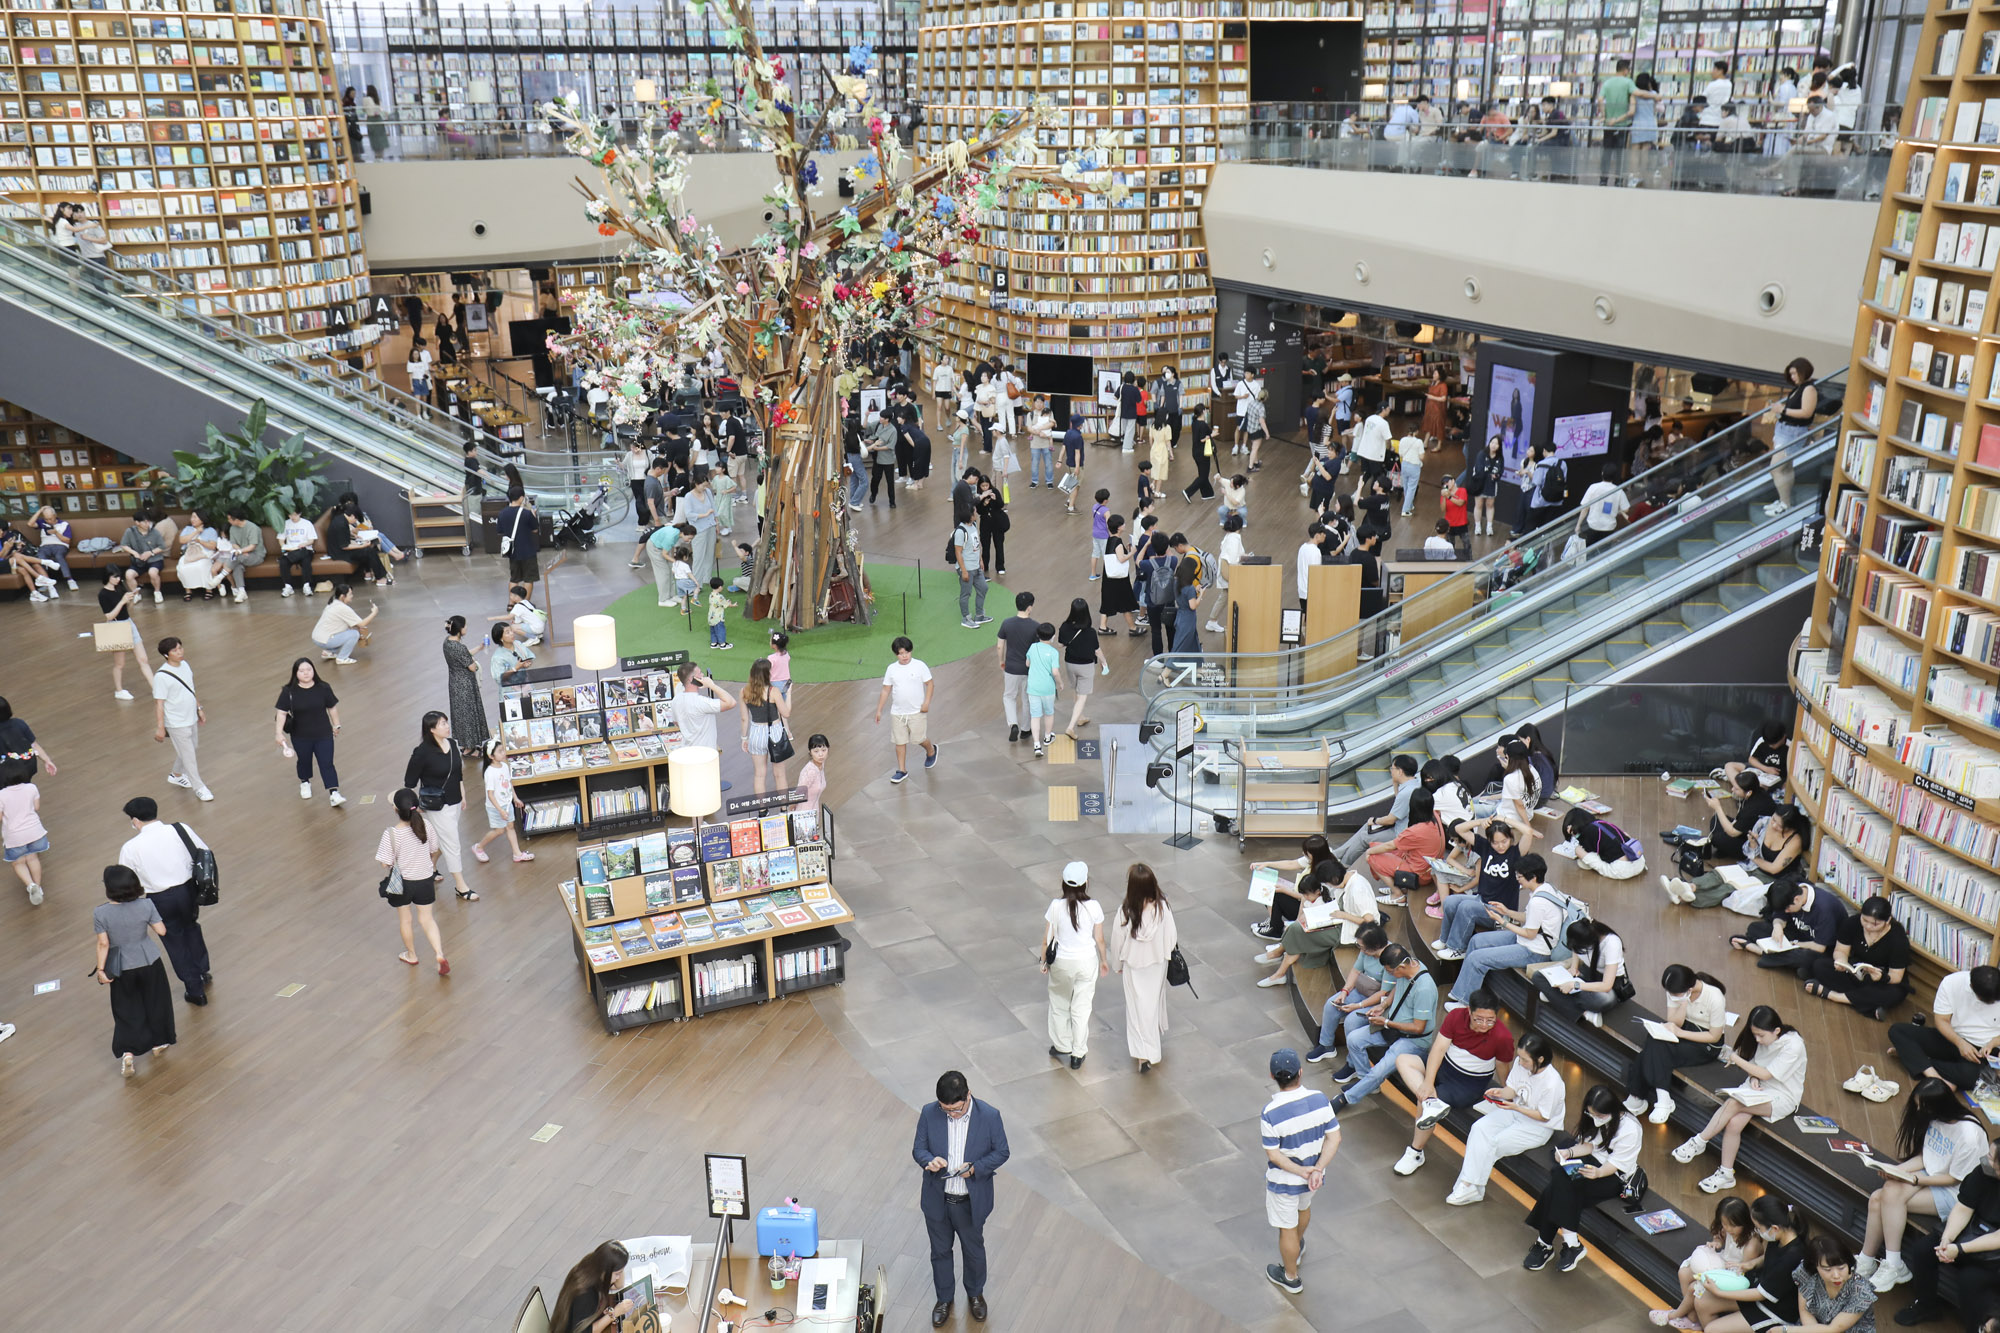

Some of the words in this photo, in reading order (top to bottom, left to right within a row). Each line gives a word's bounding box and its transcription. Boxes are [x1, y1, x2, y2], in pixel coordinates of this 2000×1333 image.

[997, 273, 1006, 286] B
[376, 297, 389, 312] A
[334, 310, 346, 325] A
[1915, 775, 1929, 788] C14
[743, 821, 758, 829] OUT
[1484, 855, 1509, 878] Lee
[820, 906, 839, 914] 02
[784, 913, 803, 921] 04
